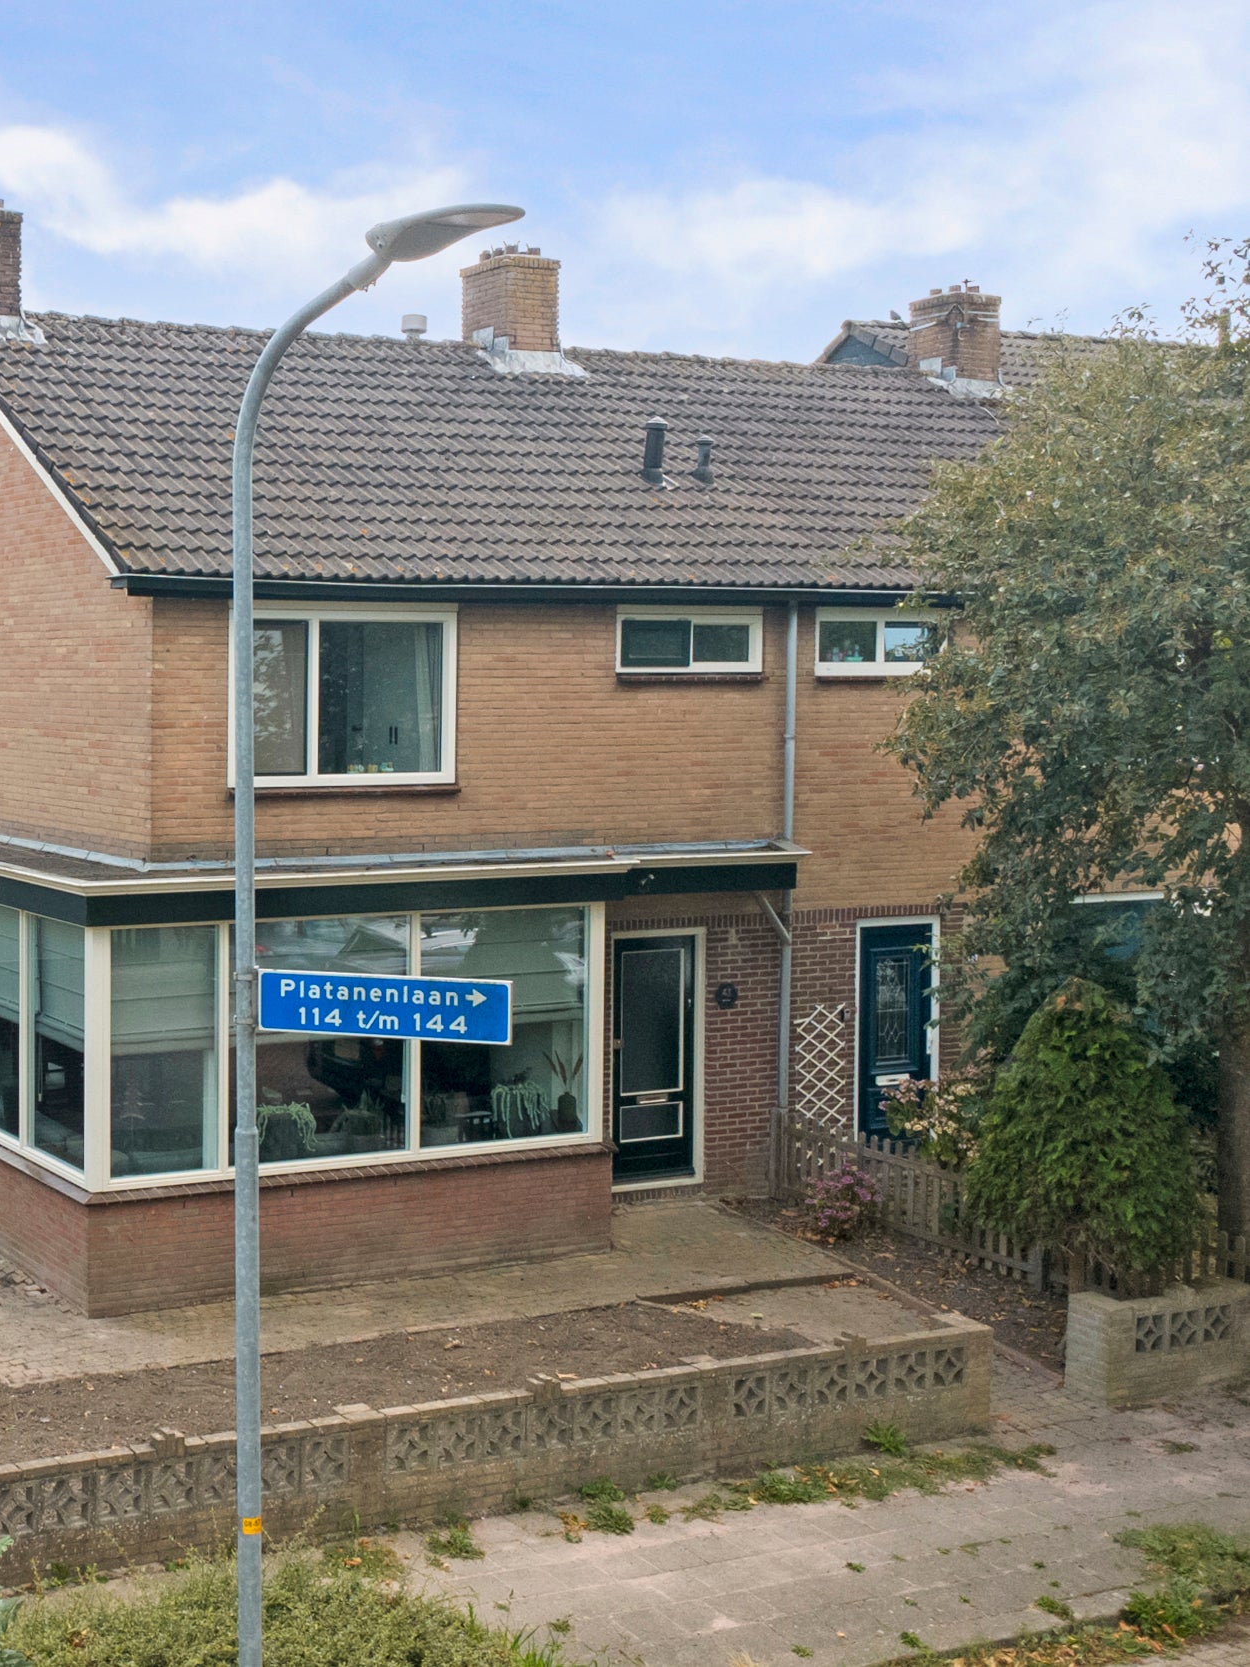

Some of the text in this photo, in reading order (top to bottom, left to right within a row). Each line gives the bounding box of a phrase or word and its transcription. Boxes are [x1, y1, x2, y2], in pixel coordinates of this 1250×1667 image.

[280, 979, 459, 1006] Platanenlaan
[299, 1007, 467, 1034] 114 t/m 144
